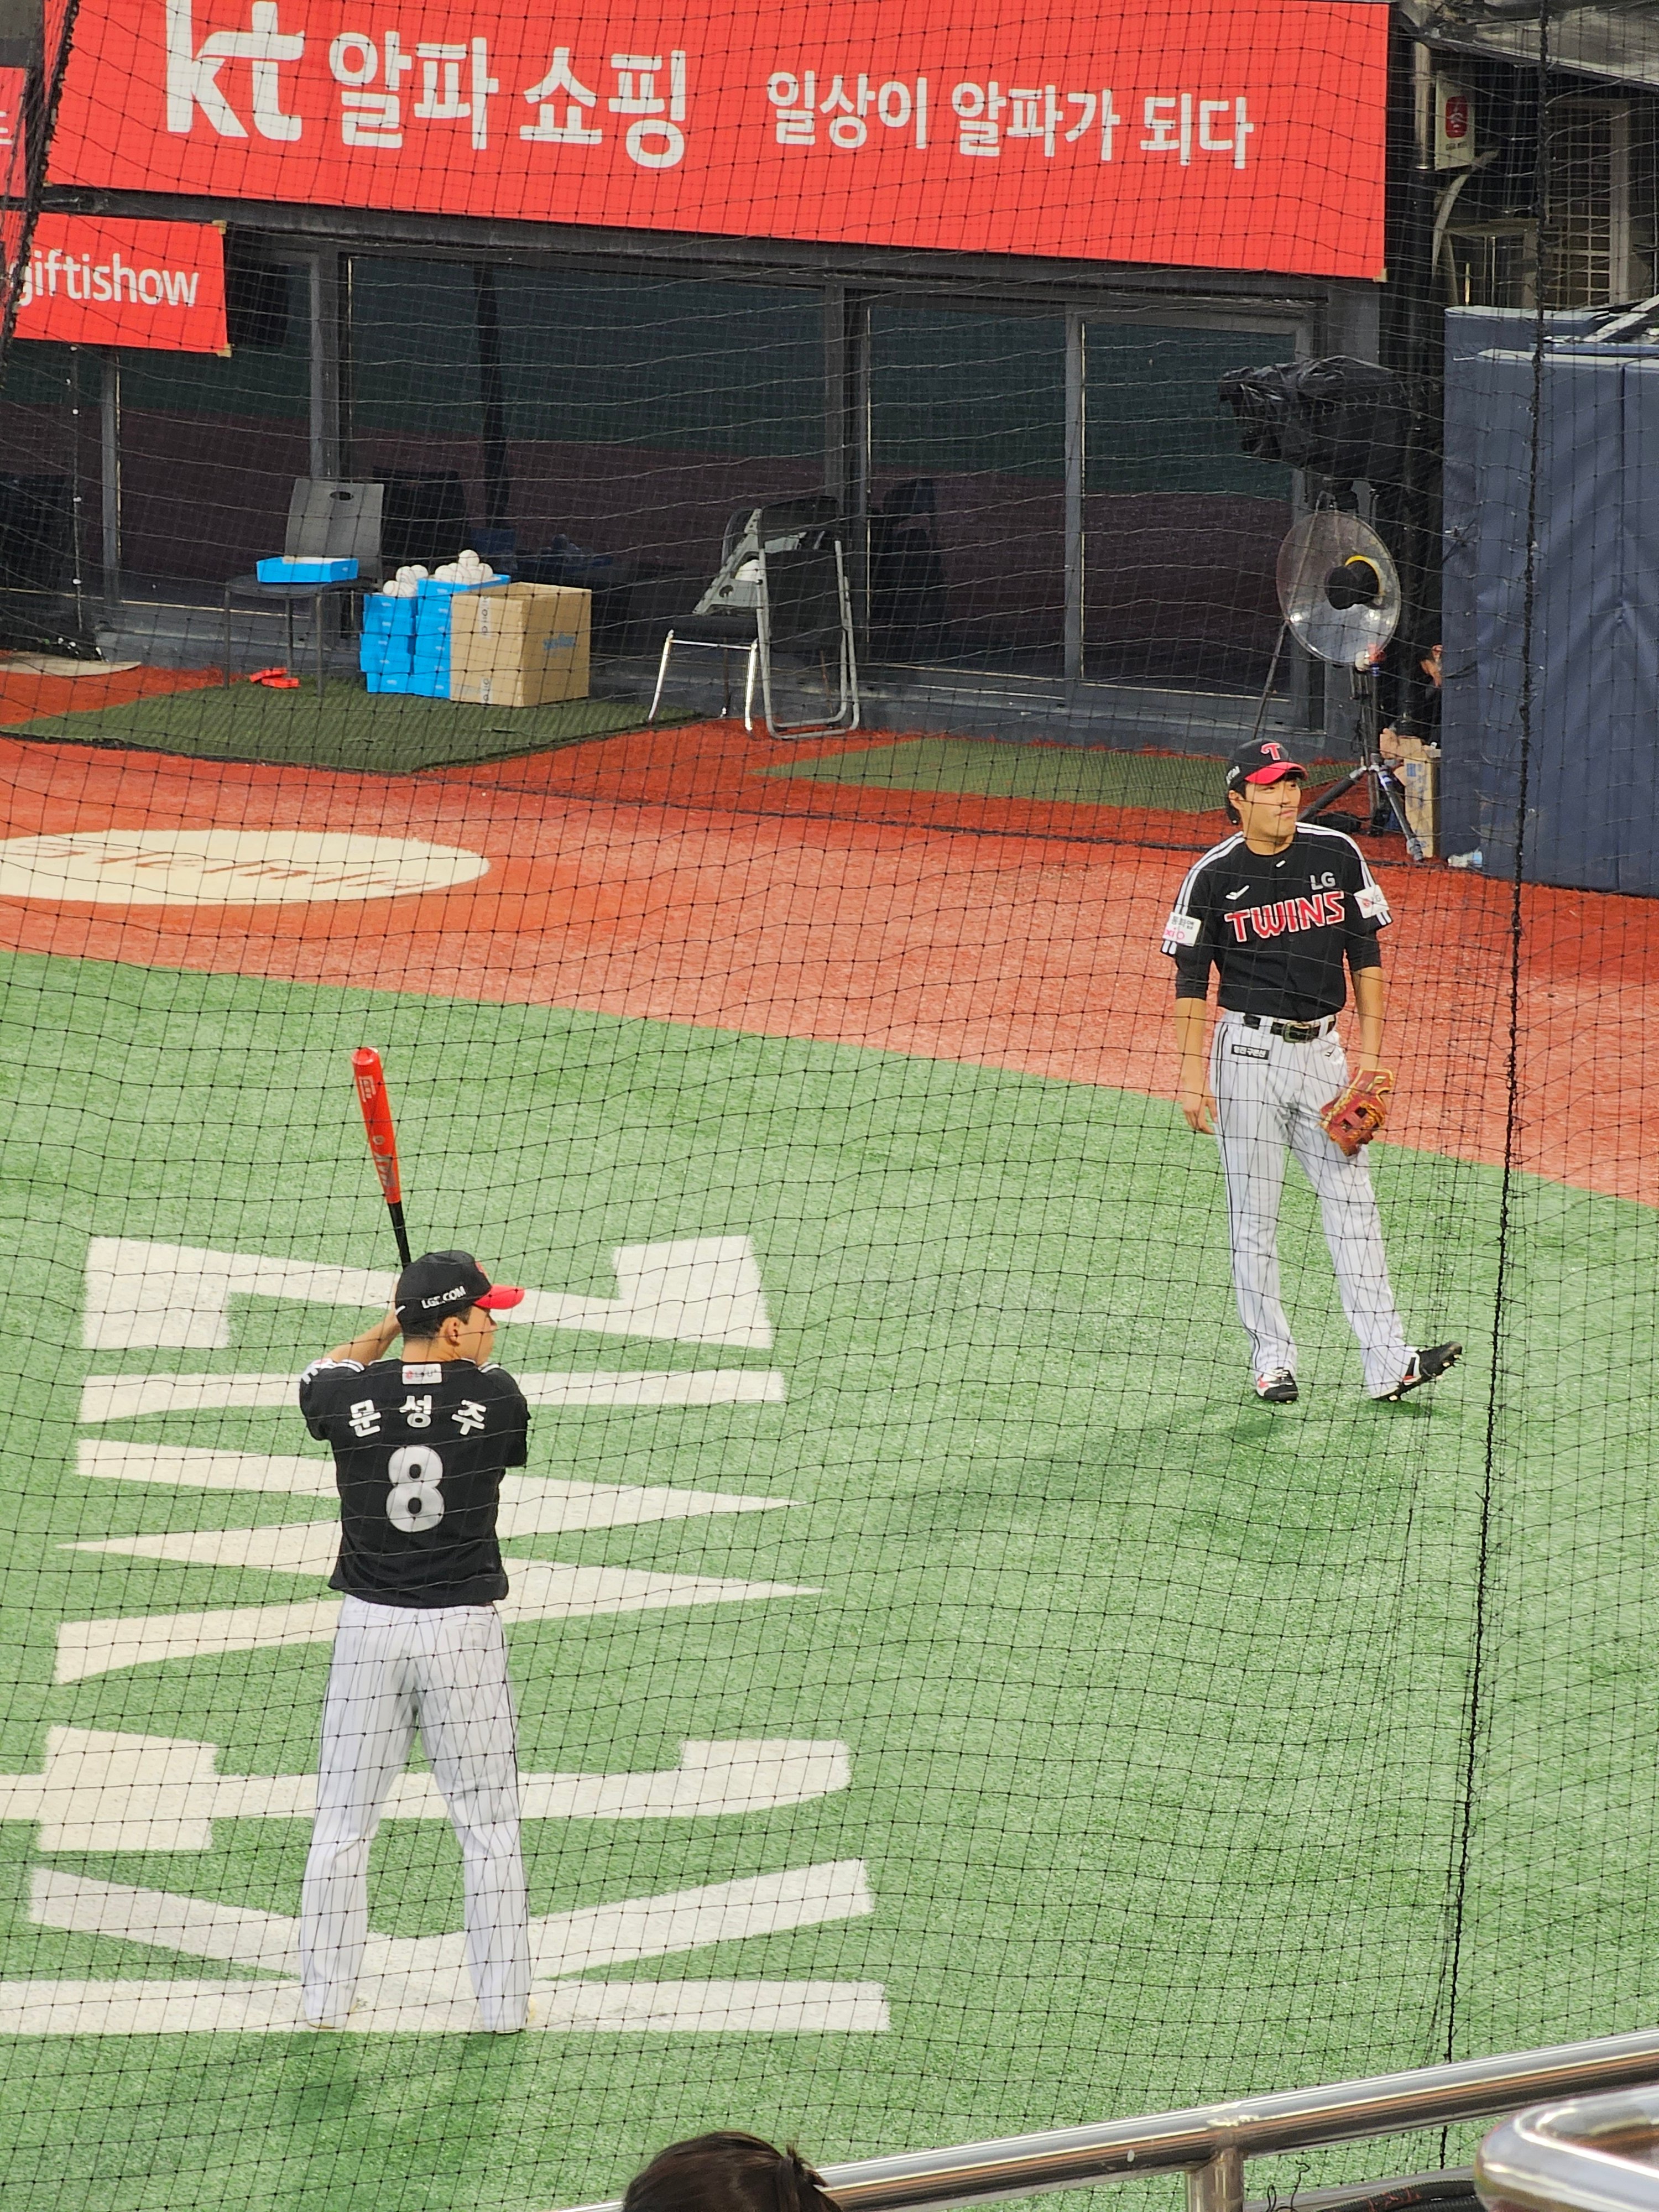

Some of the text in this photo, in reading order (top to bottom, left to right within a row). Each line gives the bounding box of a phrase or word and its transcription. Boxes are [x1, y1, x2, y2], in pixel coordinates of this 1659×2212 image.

[165, 0, 686, 168] kt 알파 쇼핑
[767, 70, 1255, 169] 일상이 알파가 되다
[9, 248, 199, 307] giftishow
[1260, 742, 1281, 761] T
[1310, 872, 1335, 890] LG
[1224, 890, 1345, 942] TWINS
[385, 1445, 445, 1532] 8
